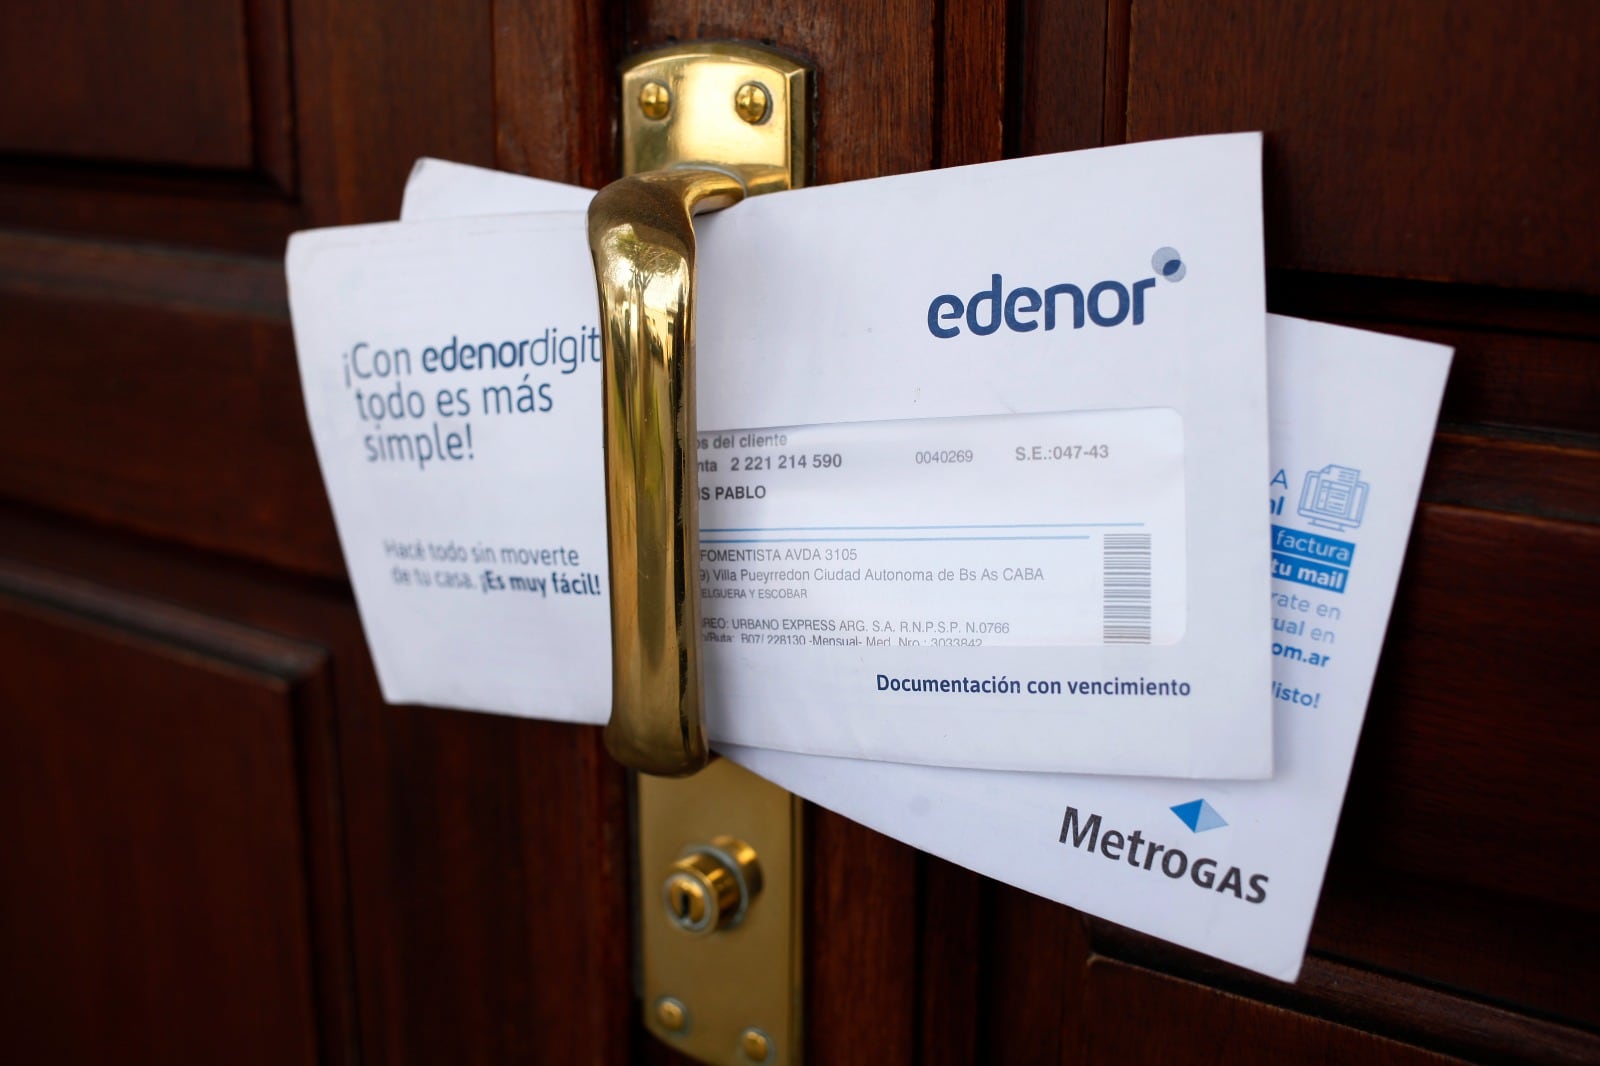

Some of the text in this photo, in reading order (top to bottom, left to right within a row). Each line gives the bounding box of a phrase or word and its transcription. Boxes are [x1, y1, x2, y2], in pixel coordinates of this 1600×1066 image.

[927, 273, 1156, 338] edenor
[342, 341, 412, 388] ¡Con
[355, 373, 553, 421] todo es más
[364, 422, 474, 470] simple!
[713, 434, 735, 449] del
[739, 433, 788, 448] cliente
[915, 450, 974, 464] 0040269
[1015, 445, 1109, 461] S.E.:047-43
[730, 456, 740, 471] 2
[745, 456, 772, 470] 221
[778, 455, 807, 469] 214
[812, 453, 843, 468] 590
[715, 485, 766, 500] PABLO
[382, 539, 580, 566] Hacé todo sin moverte
[1276, 530, 1350, 562] factura
[700, 548, 858, 562] FOMENTISTA AVDA 3105
[391, 565, 411, 585] de
[413, 567, 431, 587] tu
[480, 570, 505, 594] ¡Es
[509, 575, 547, 598] muy
[551, 572, 602, 595] fácil!
[712, 569, 737, 581] Villa
[740, 568, 809, 584] Pueyrredon
[814, 568, 860, 581] Ciudad
[864, 569, 934, 582] Autonoma
[937, 568, 954, 581] de
[959, 568, 977, 581] Bs
[981, 568, 998, 581] As
[1002, 567, 1044, 581] CABA
[1297, 564, 1345, 589] mail
[749, 589, 756, 598] Y
[759, 589, 808, 599] ESCOBAR
[1316, 603, 1341, 620] en
[732, 618, 780, 631] URBANO
[783, 619, 836, 632] EXPRESS
[839, 620, 869, 632] ARG.
[872, 621, 896, 633] S.A.
[900, 621, 962, 634] R.N.P.S.P.
[966, 621, 1010, 634] N.0766
[1311, 627, 1335, 644] en
[876, 674, 1191, 696] Documentación con vencimiento
